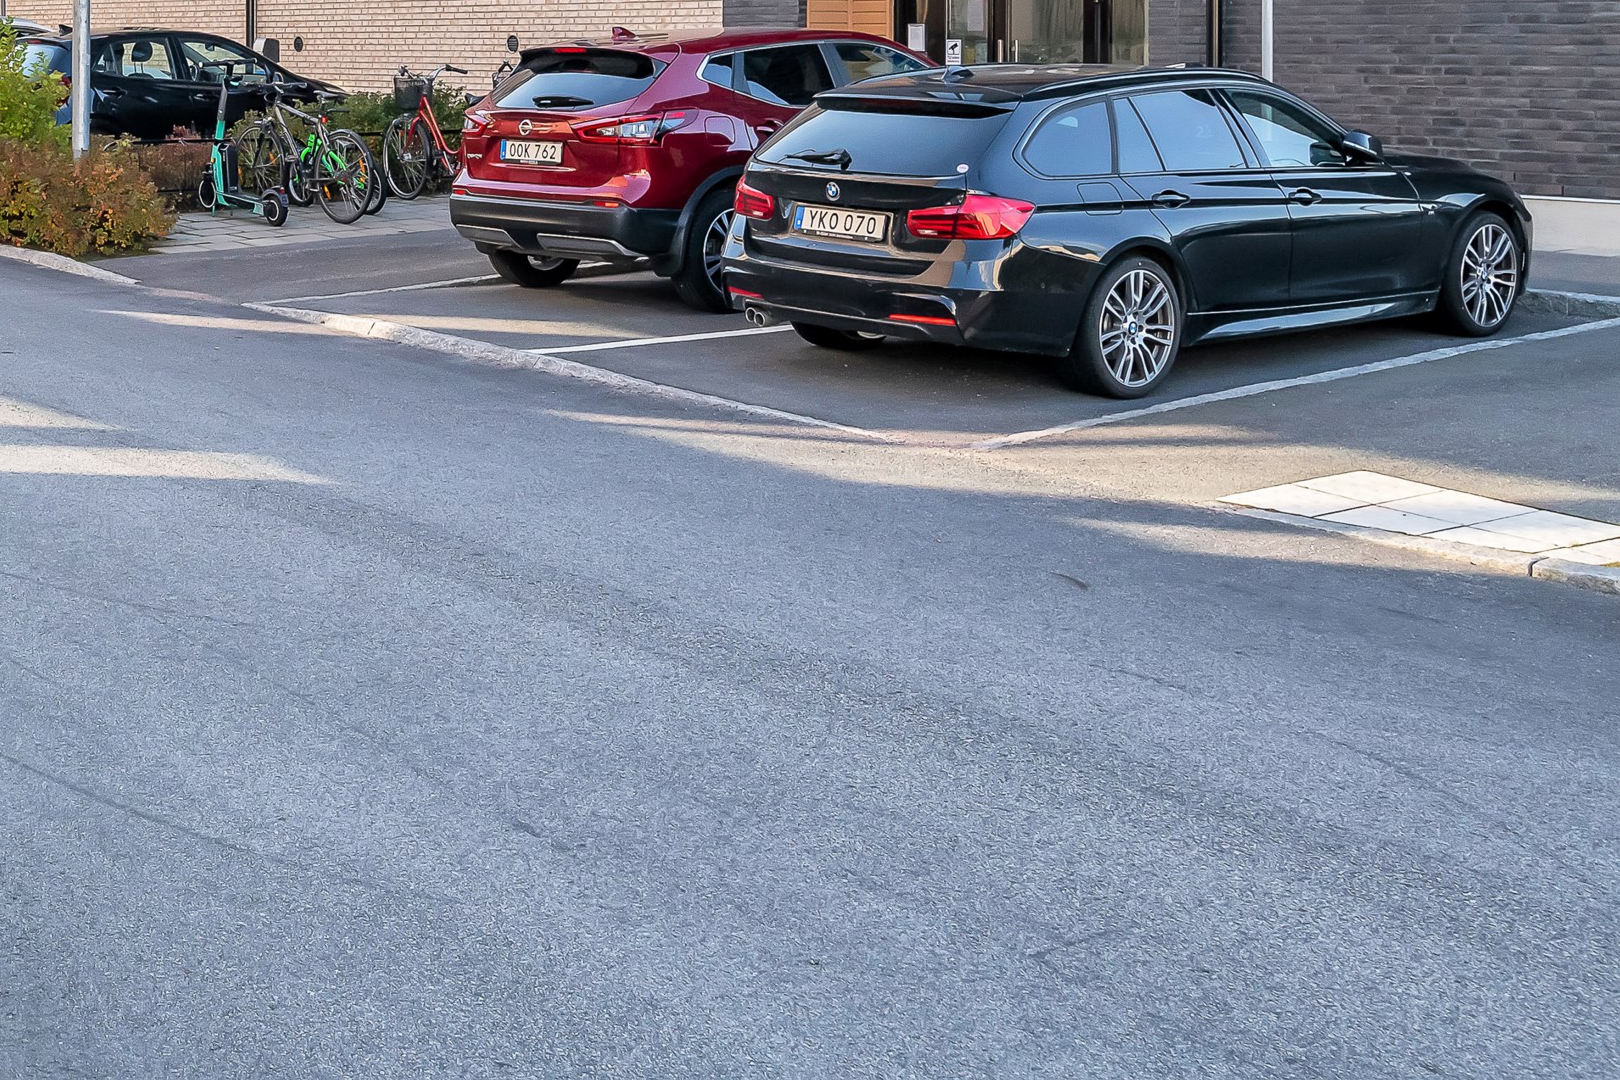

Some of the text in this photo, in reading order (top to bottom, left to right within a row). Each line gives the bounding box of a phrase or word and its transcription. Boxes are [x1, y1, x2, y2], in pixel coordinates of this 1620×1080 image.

[509, 143, 556, 160] OOK 762
[809, 209, 877, 235] YKO 070
